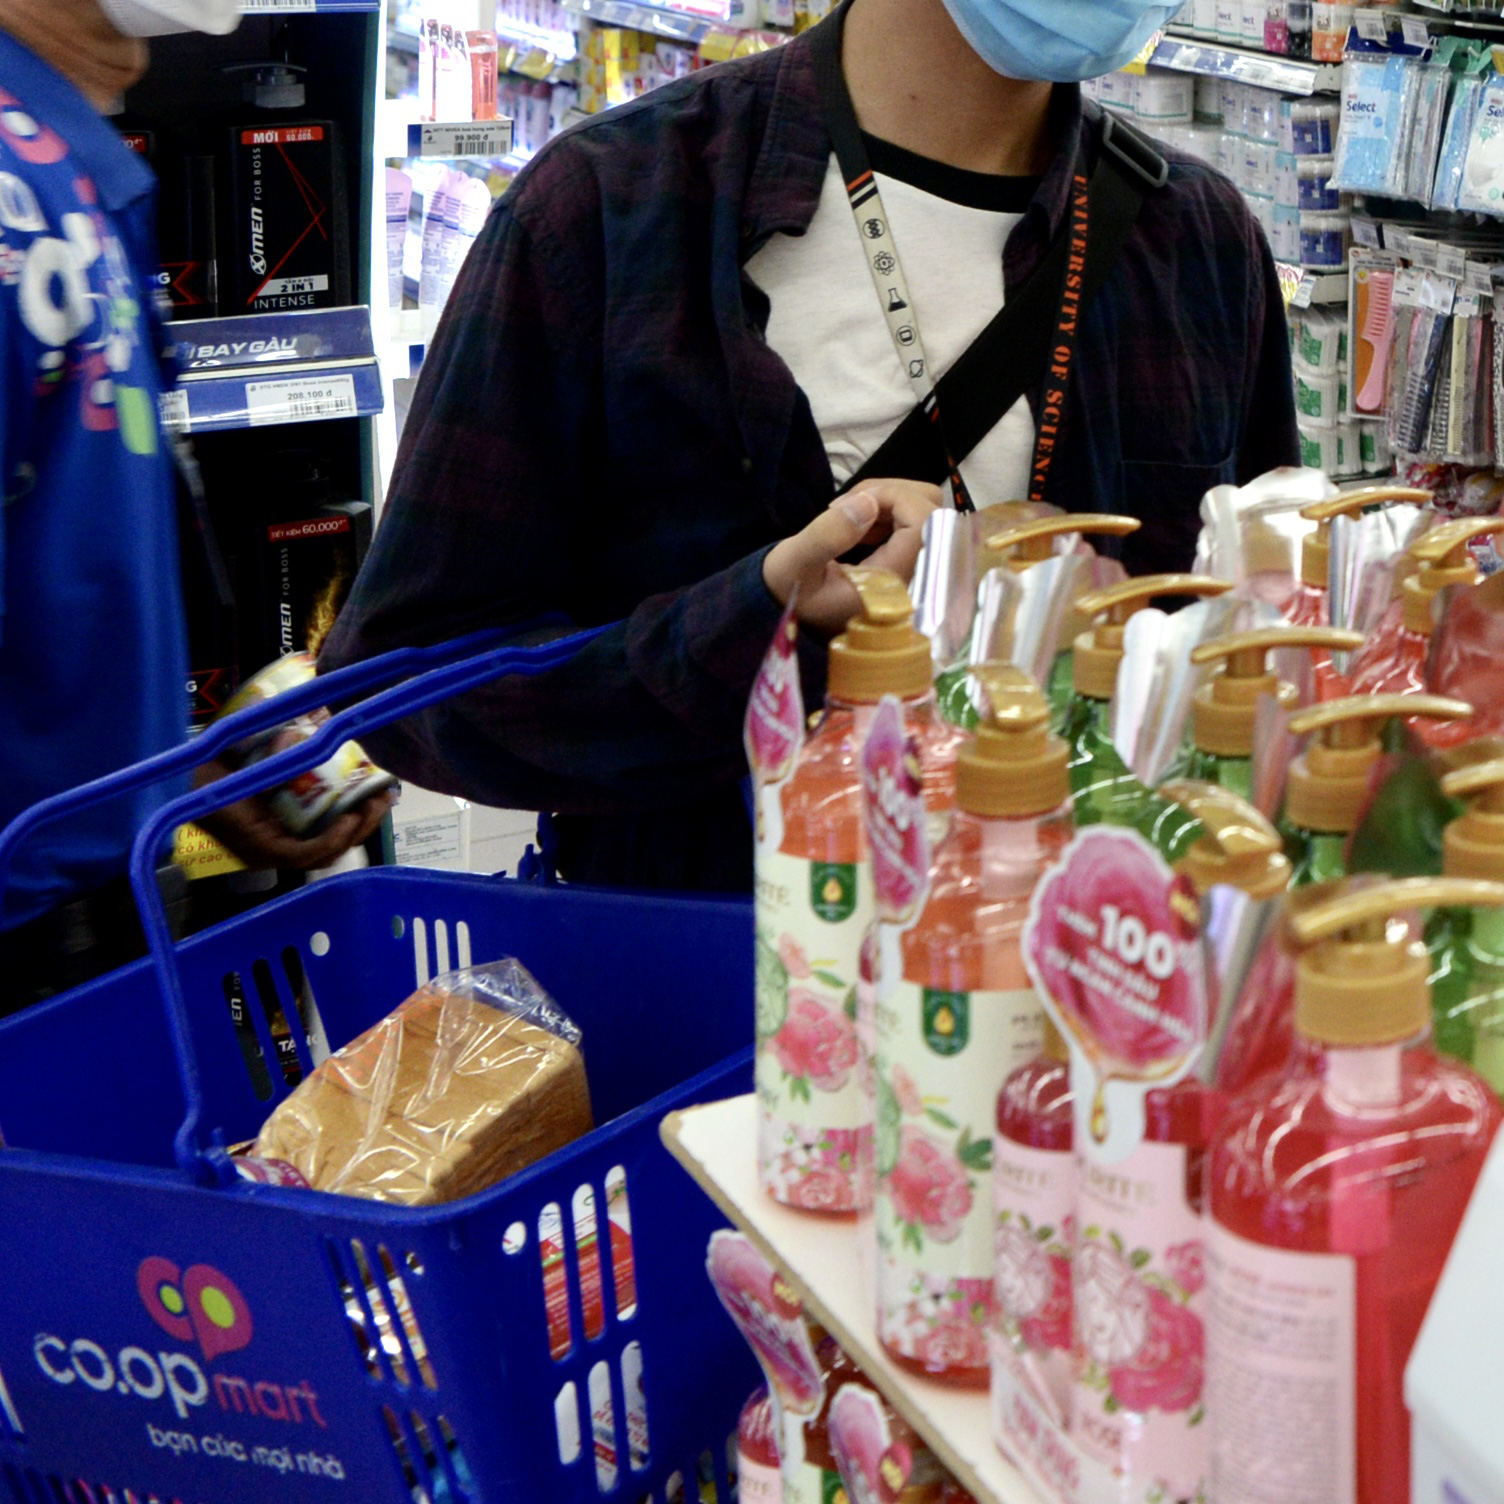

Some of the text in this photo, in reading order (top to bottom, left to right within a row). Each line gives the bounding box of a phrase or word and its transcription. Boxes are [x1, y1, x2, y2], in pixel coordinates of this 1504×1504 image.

[1346, 100, 1377, 113] Select
[253, 129, 279, 144] MỚI
[454, 133, 480, 141] 99.900
[253, 147, 262, 200] FOR BOSS
[1058, 175, 1089, 336] UNIVERSITY
[254, 295, 315, 309] INTENSE
[197, 337, 297, 359] BAY GÀU
[1051, 345, 1071, 381] OF
[282, 577, 290, 595] FOR
[146, 1422, 197, 1458] bạn
[252, 1442, 291, 1472] mọi
[296, 1448, 346, 1481] nhà
